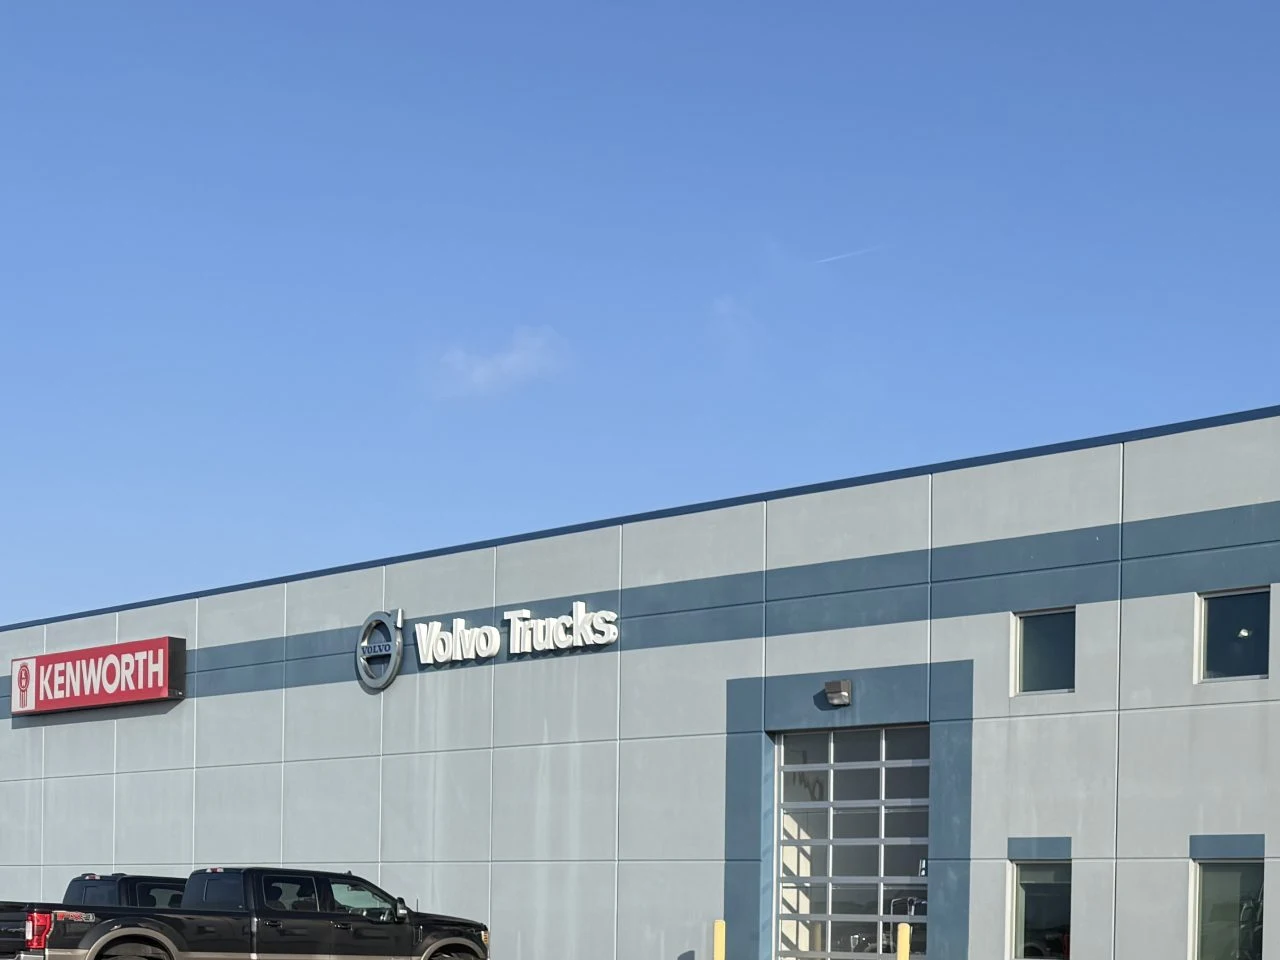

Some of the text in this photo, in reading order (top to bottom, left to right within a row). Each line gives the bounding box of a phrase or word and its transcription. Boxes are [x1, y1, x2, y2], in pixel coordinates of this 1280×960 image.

[361, 643, 391, 655] VOLVO
[415, 600, 618, 664] Volvo Trucks
[39, 648, 164, 700] KENWORTH
